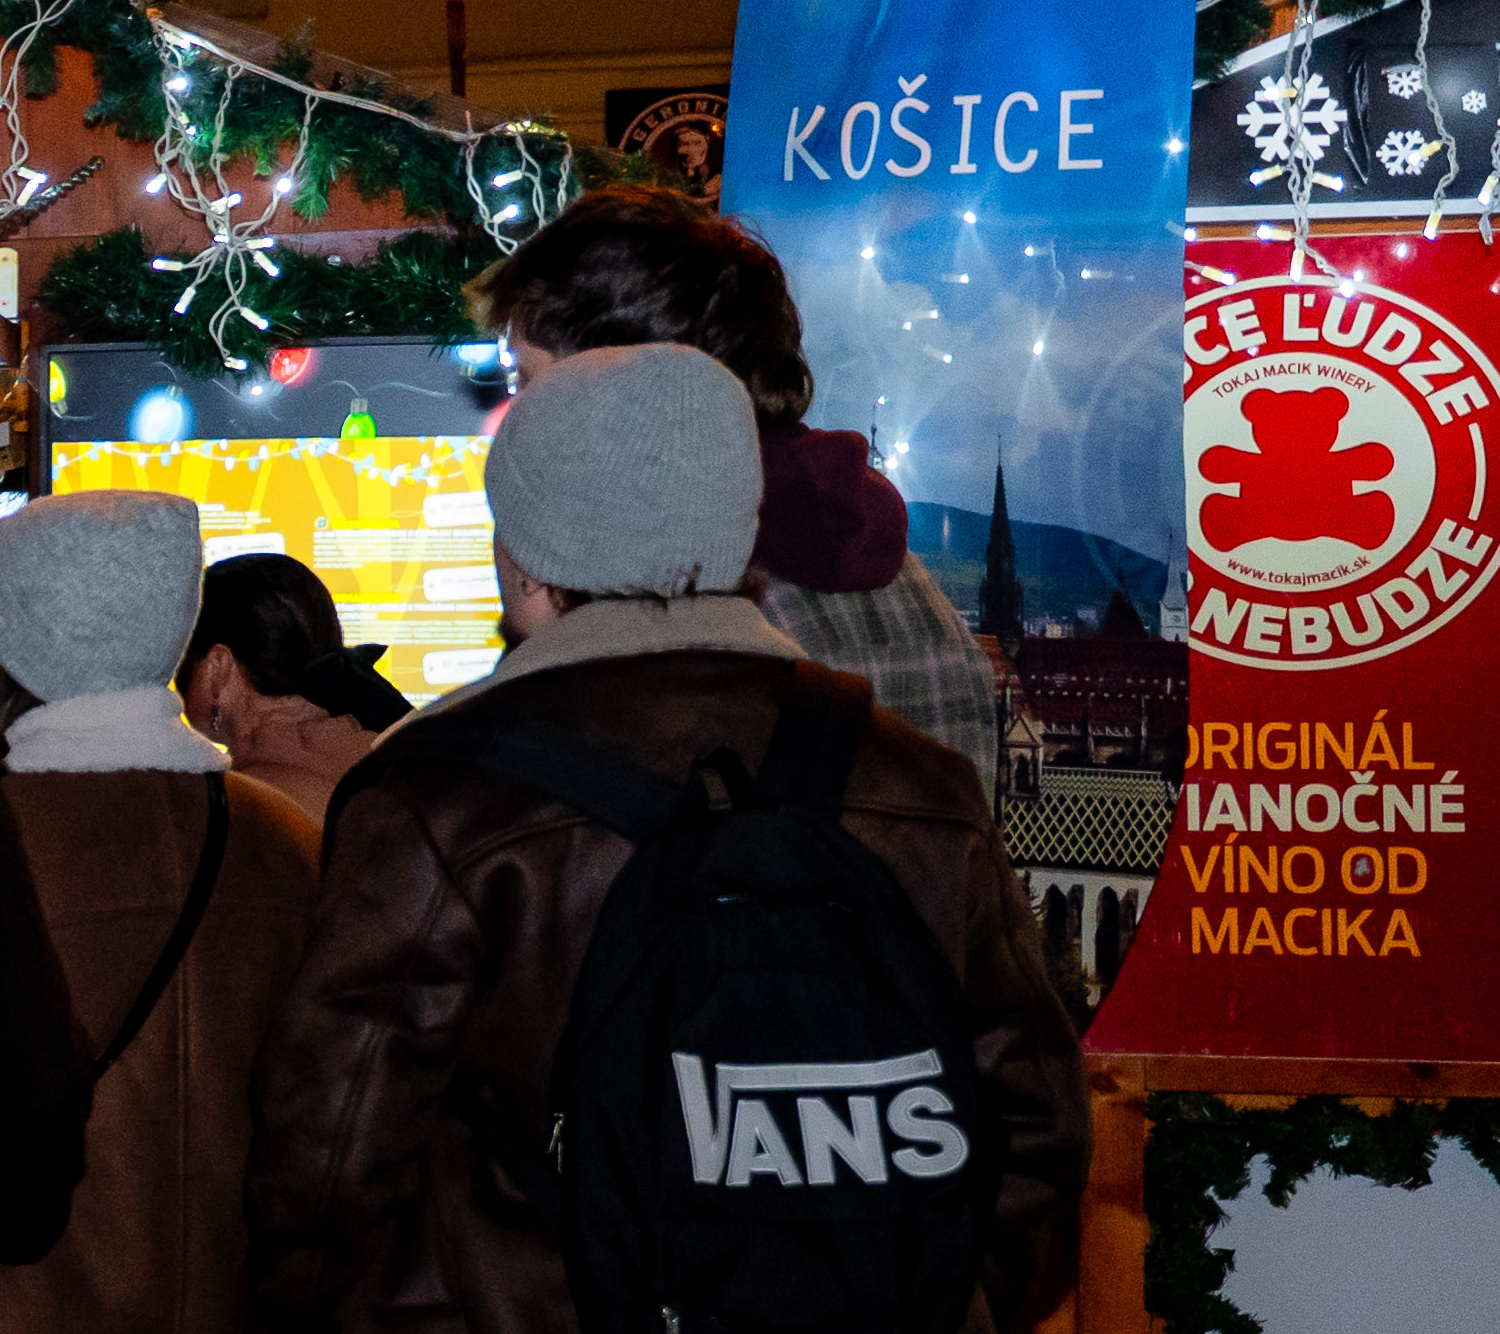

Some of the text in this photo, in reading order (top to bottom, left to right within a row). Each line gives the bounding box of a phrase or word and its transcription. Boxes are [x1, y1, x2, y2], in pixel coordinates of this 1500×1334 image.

[632, 99, 729, 143] GERONI
[783, 72, 1104, 182] KOŠICE
[1211, 362, 1376, 399] TOKAJ MACIK WINERY
[1190, 517, 1493, 656] NEBUDZE
[1227, 555, 1371, 587] www.tokajmacik.sk
[1179, 770, 1466, 833] IANOČNÉ
[1179, 832, 1428, 896] VÍNO OD
[1190, 906, 1422, 958] MACIKA
[672, 1048, 970, 1187] VANS
